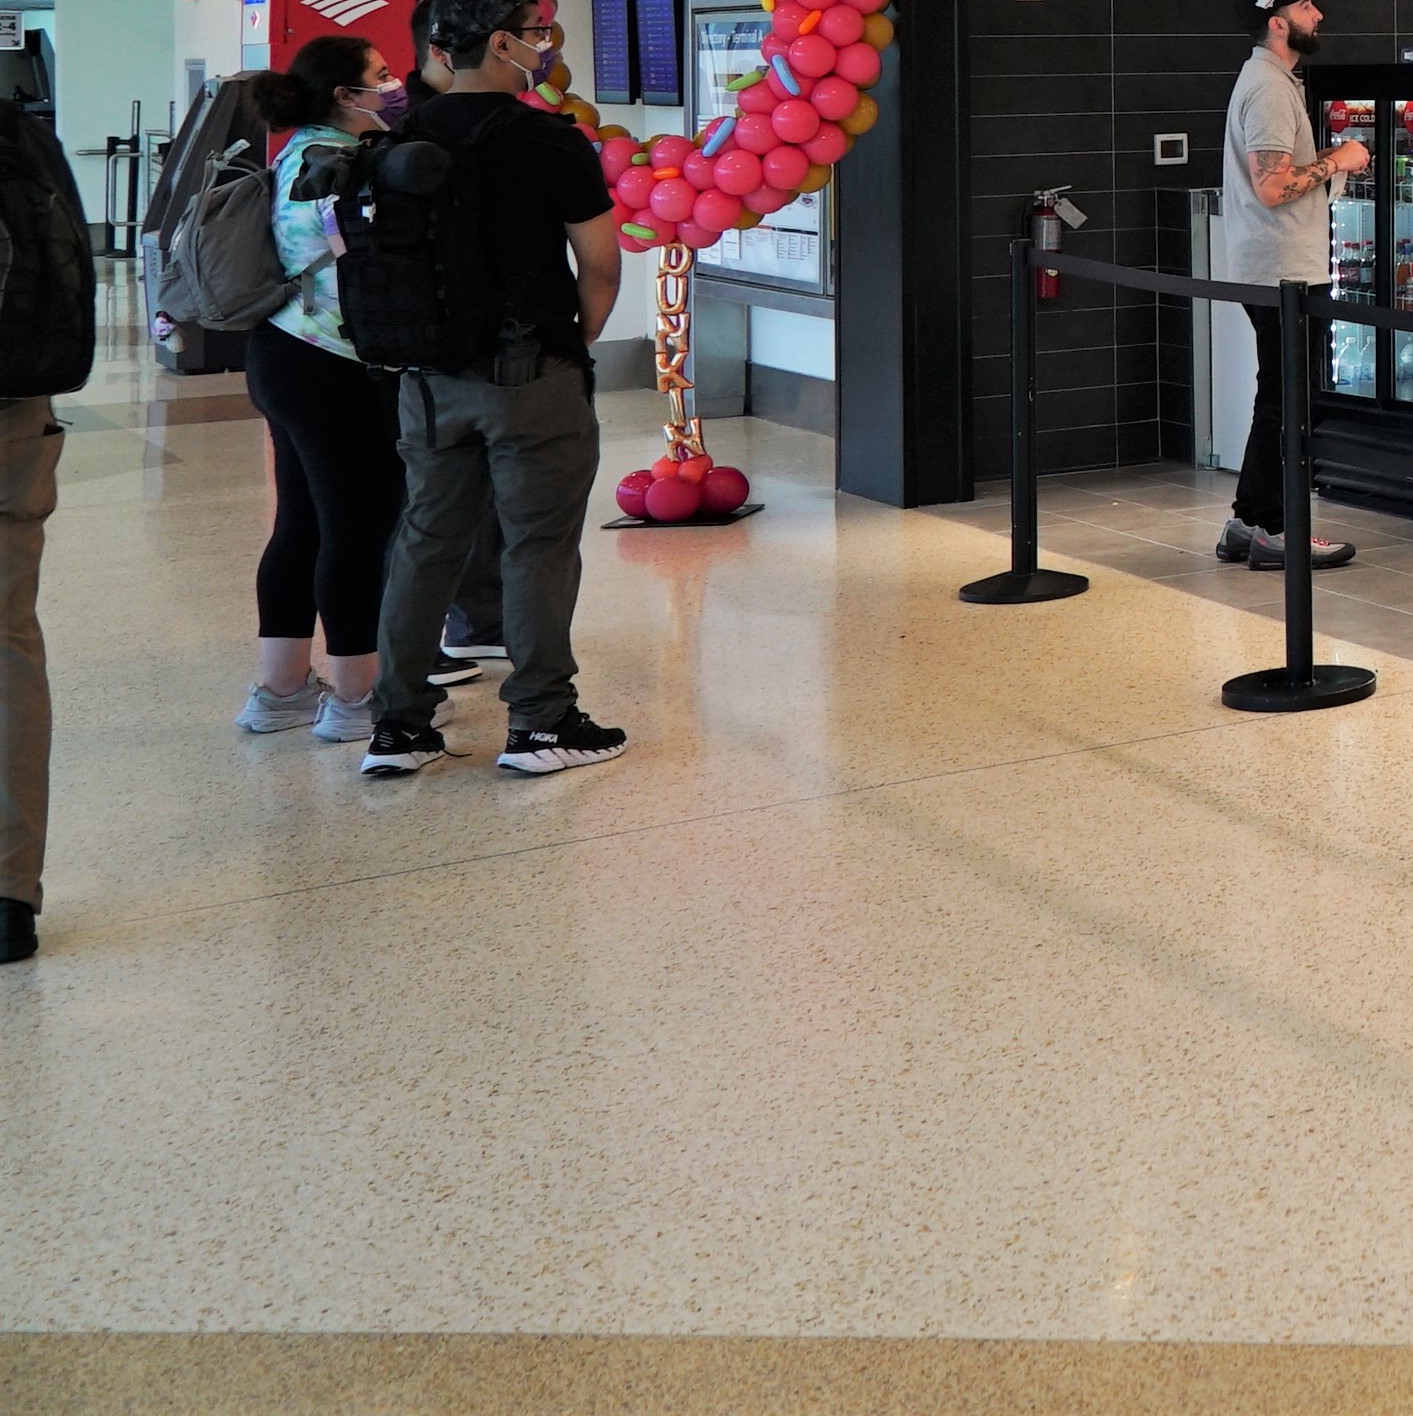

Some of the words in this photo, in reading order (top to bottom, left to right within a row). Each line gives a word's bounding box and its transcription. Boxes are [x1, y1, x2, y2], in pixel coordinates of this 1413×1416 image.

[1349, 115, 1359, 123] ICE
[1360, 114, 1375, 123] COLD
[529, 731, 558, 744] HOKA
